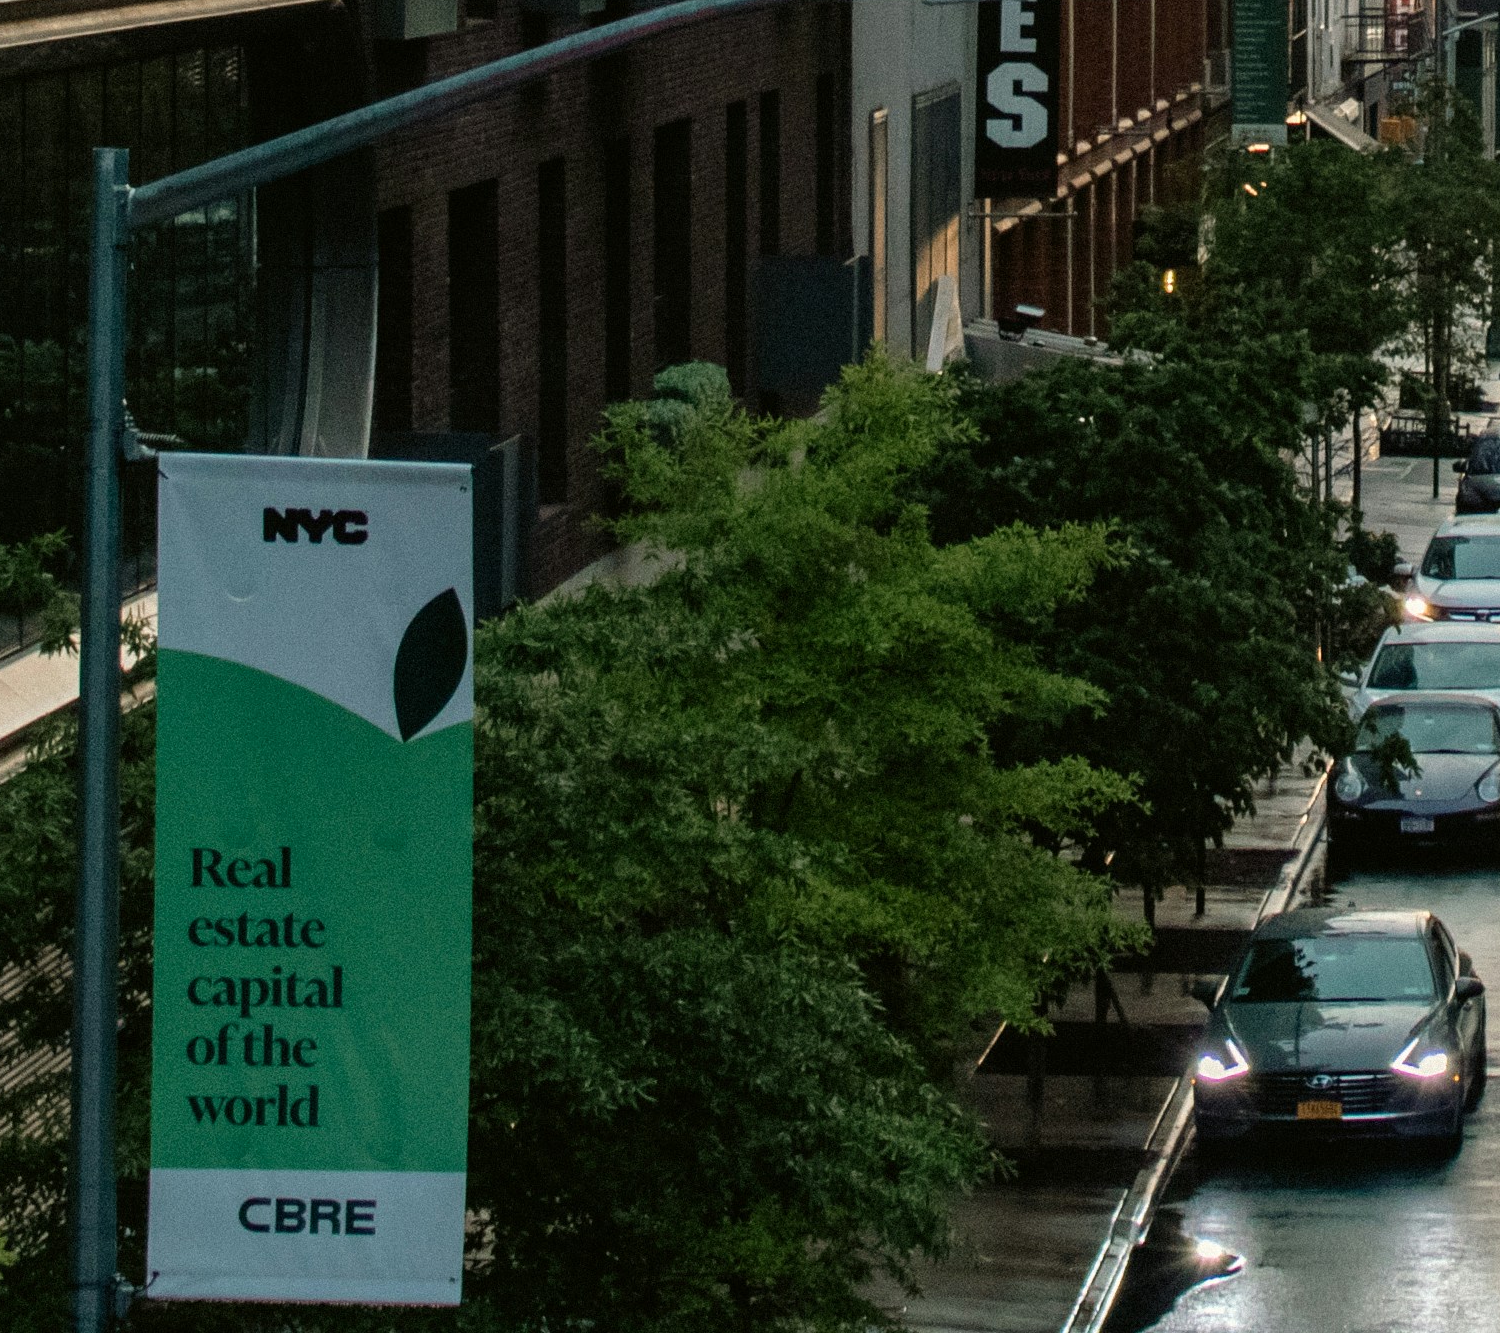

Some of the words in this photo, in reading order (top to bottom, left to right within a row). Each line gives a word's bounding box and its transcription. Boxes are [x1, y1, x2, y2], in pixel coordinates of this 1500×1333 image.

[262, 507, 369, 546] NYC
[190, 846, 293, 890] Real
[187, 912, 327, 950] estate
[186, 965, 344, 1019] capital
[185, 1023, 238, 1068] of
[242, 1023, 318, 1068] the
[186, 1084, 320, 1129] world
[238, 1197, 377, 1237] CBRE
